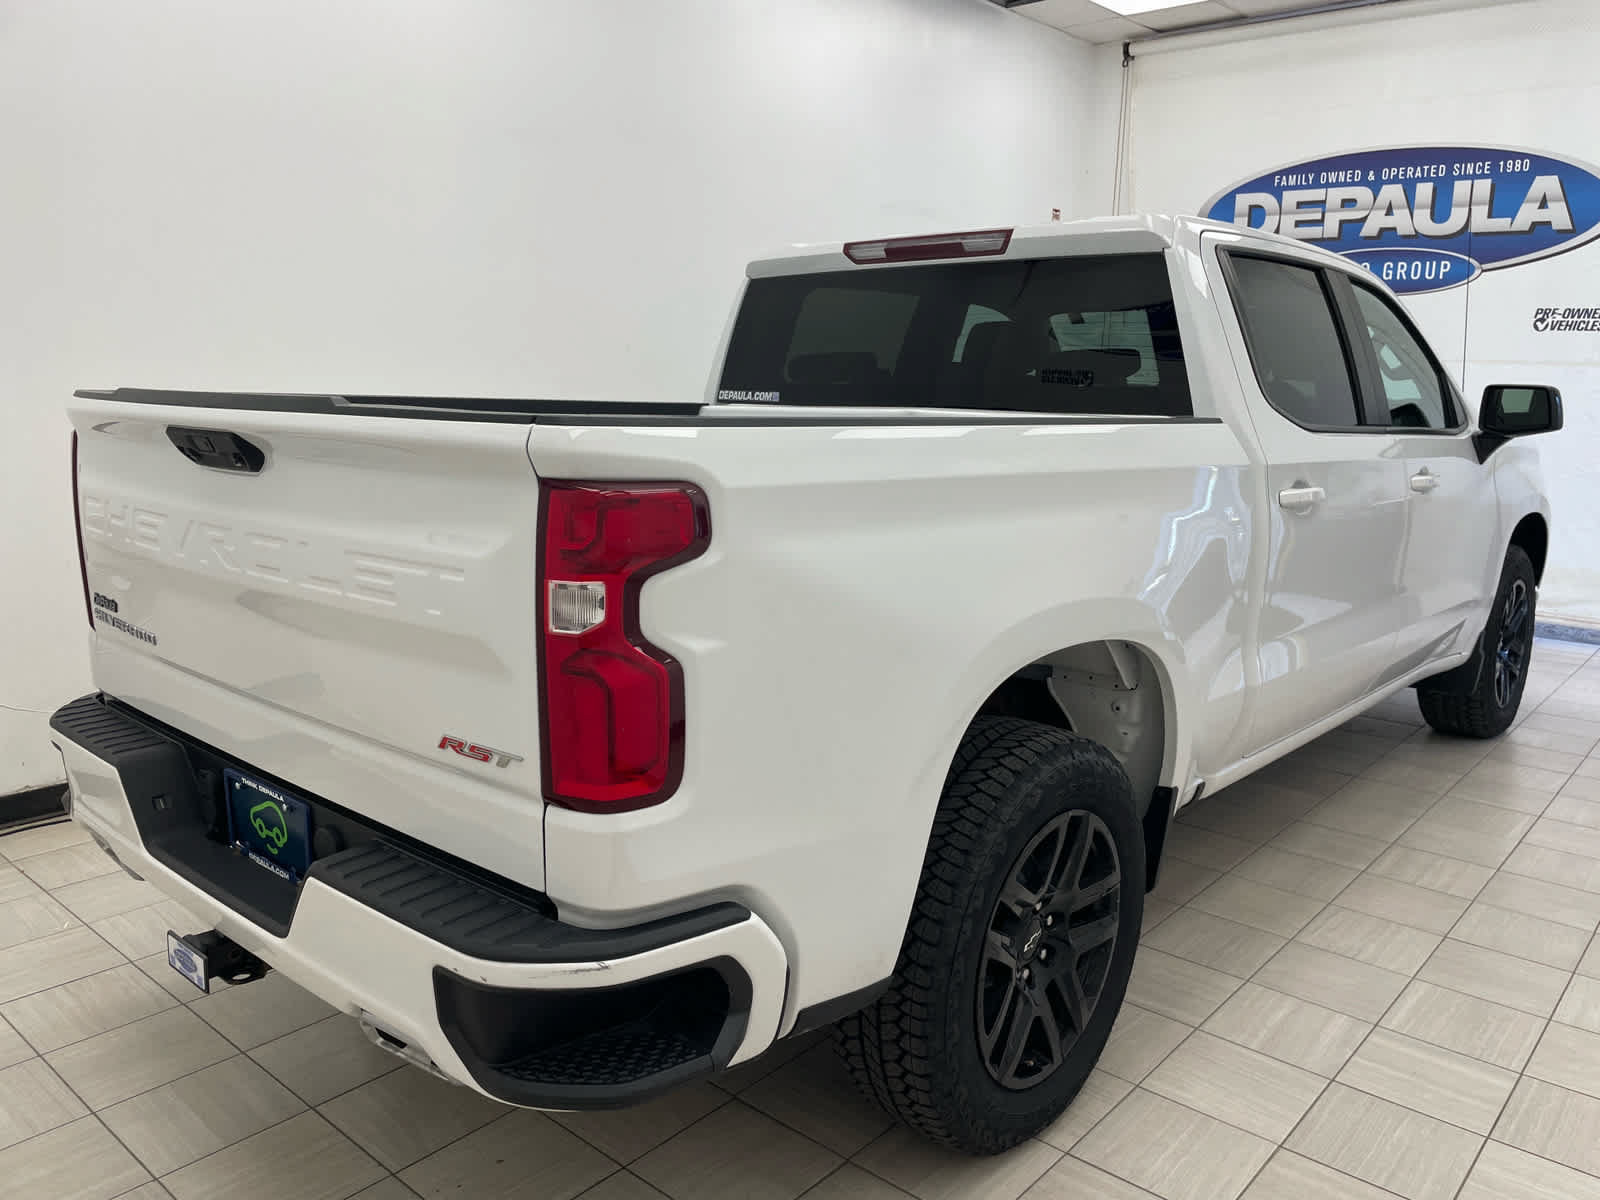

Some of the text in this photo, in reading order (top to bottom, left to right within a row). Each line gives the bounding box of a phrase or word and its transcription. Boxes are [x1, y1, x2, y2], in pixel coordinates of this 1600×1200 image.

[1273, 158, 1530, 188] FAMILY OWNED & OPERATED SINCE 1980
[1233, 175, 1575, 241] DEPAULA
[1382, 260, 1451, 280] GROUP
[718, 390, 772, 401] DEPAULA.COM
[83, 495, 466, 618] CHEVROLET
[437, 735, 524, 769] RST
